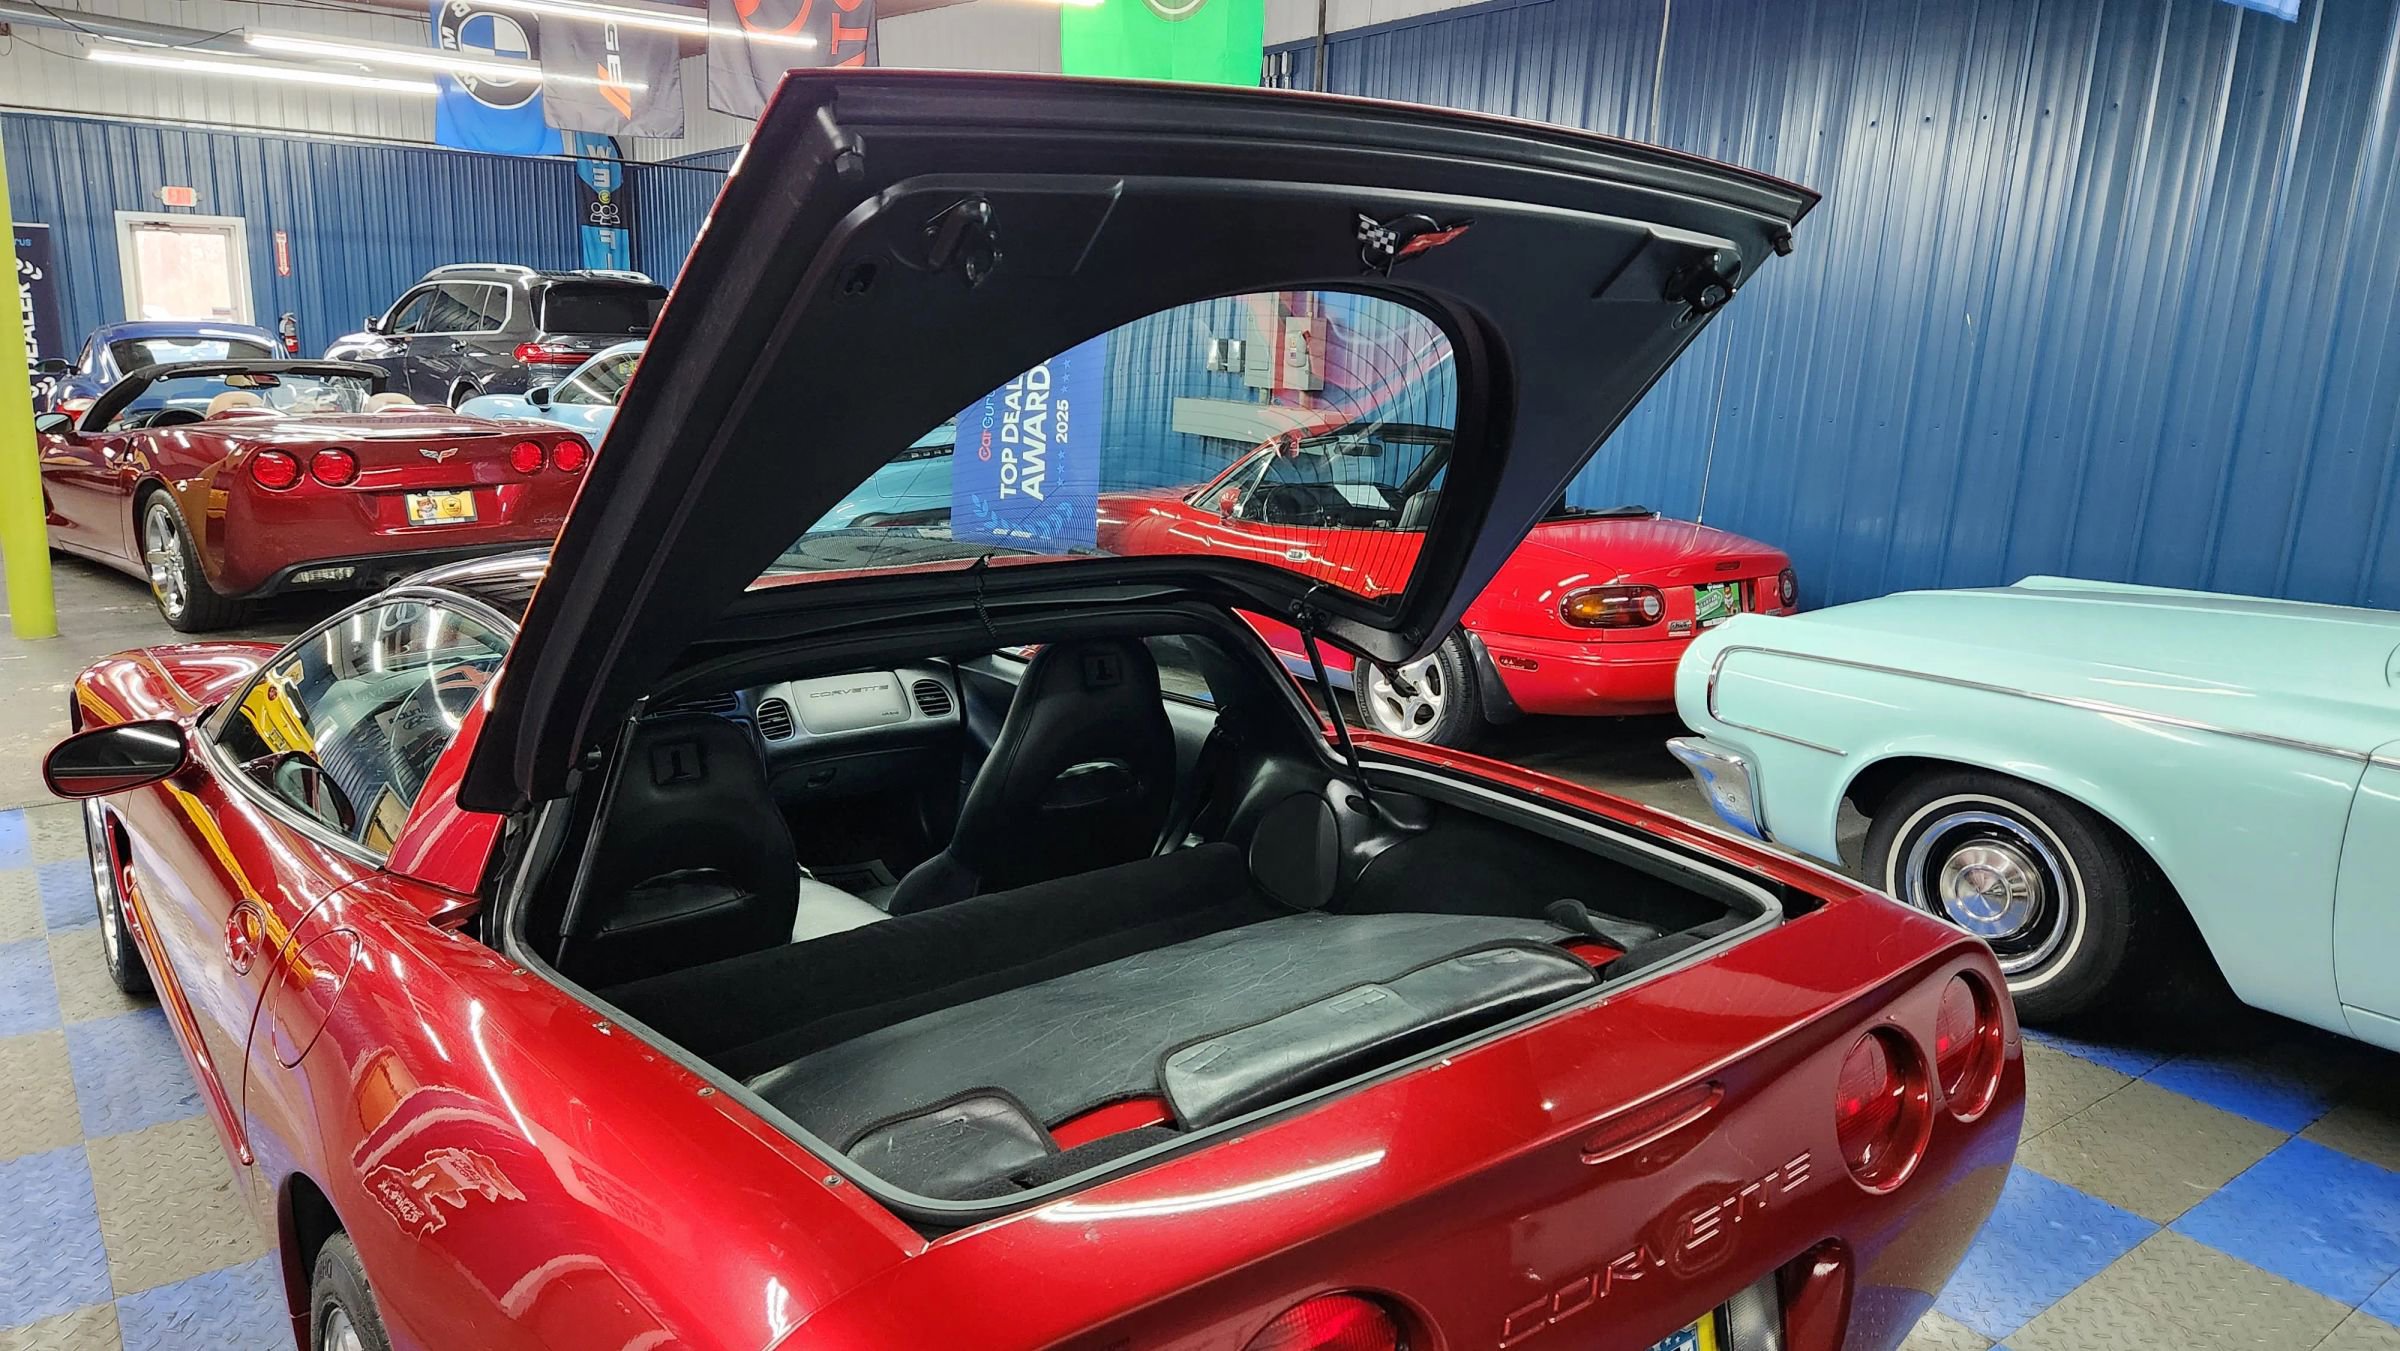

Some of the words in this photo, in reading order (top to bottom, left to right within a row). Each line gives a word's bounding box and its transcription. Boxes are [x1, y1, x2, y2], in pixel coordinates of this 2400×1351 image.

[605, 23, 623, 85] GE
[1002, 373, 1023, 443] DEAL
[1021, 358, 1051, 501] AWARD
[1055, 399, 1070, 444] 2025
[1000, 447, 1018, 499] TOP
[810, 684, 889, 698] CORVETTE
[1499, 1149, 1812, 1350] CORVETTE
